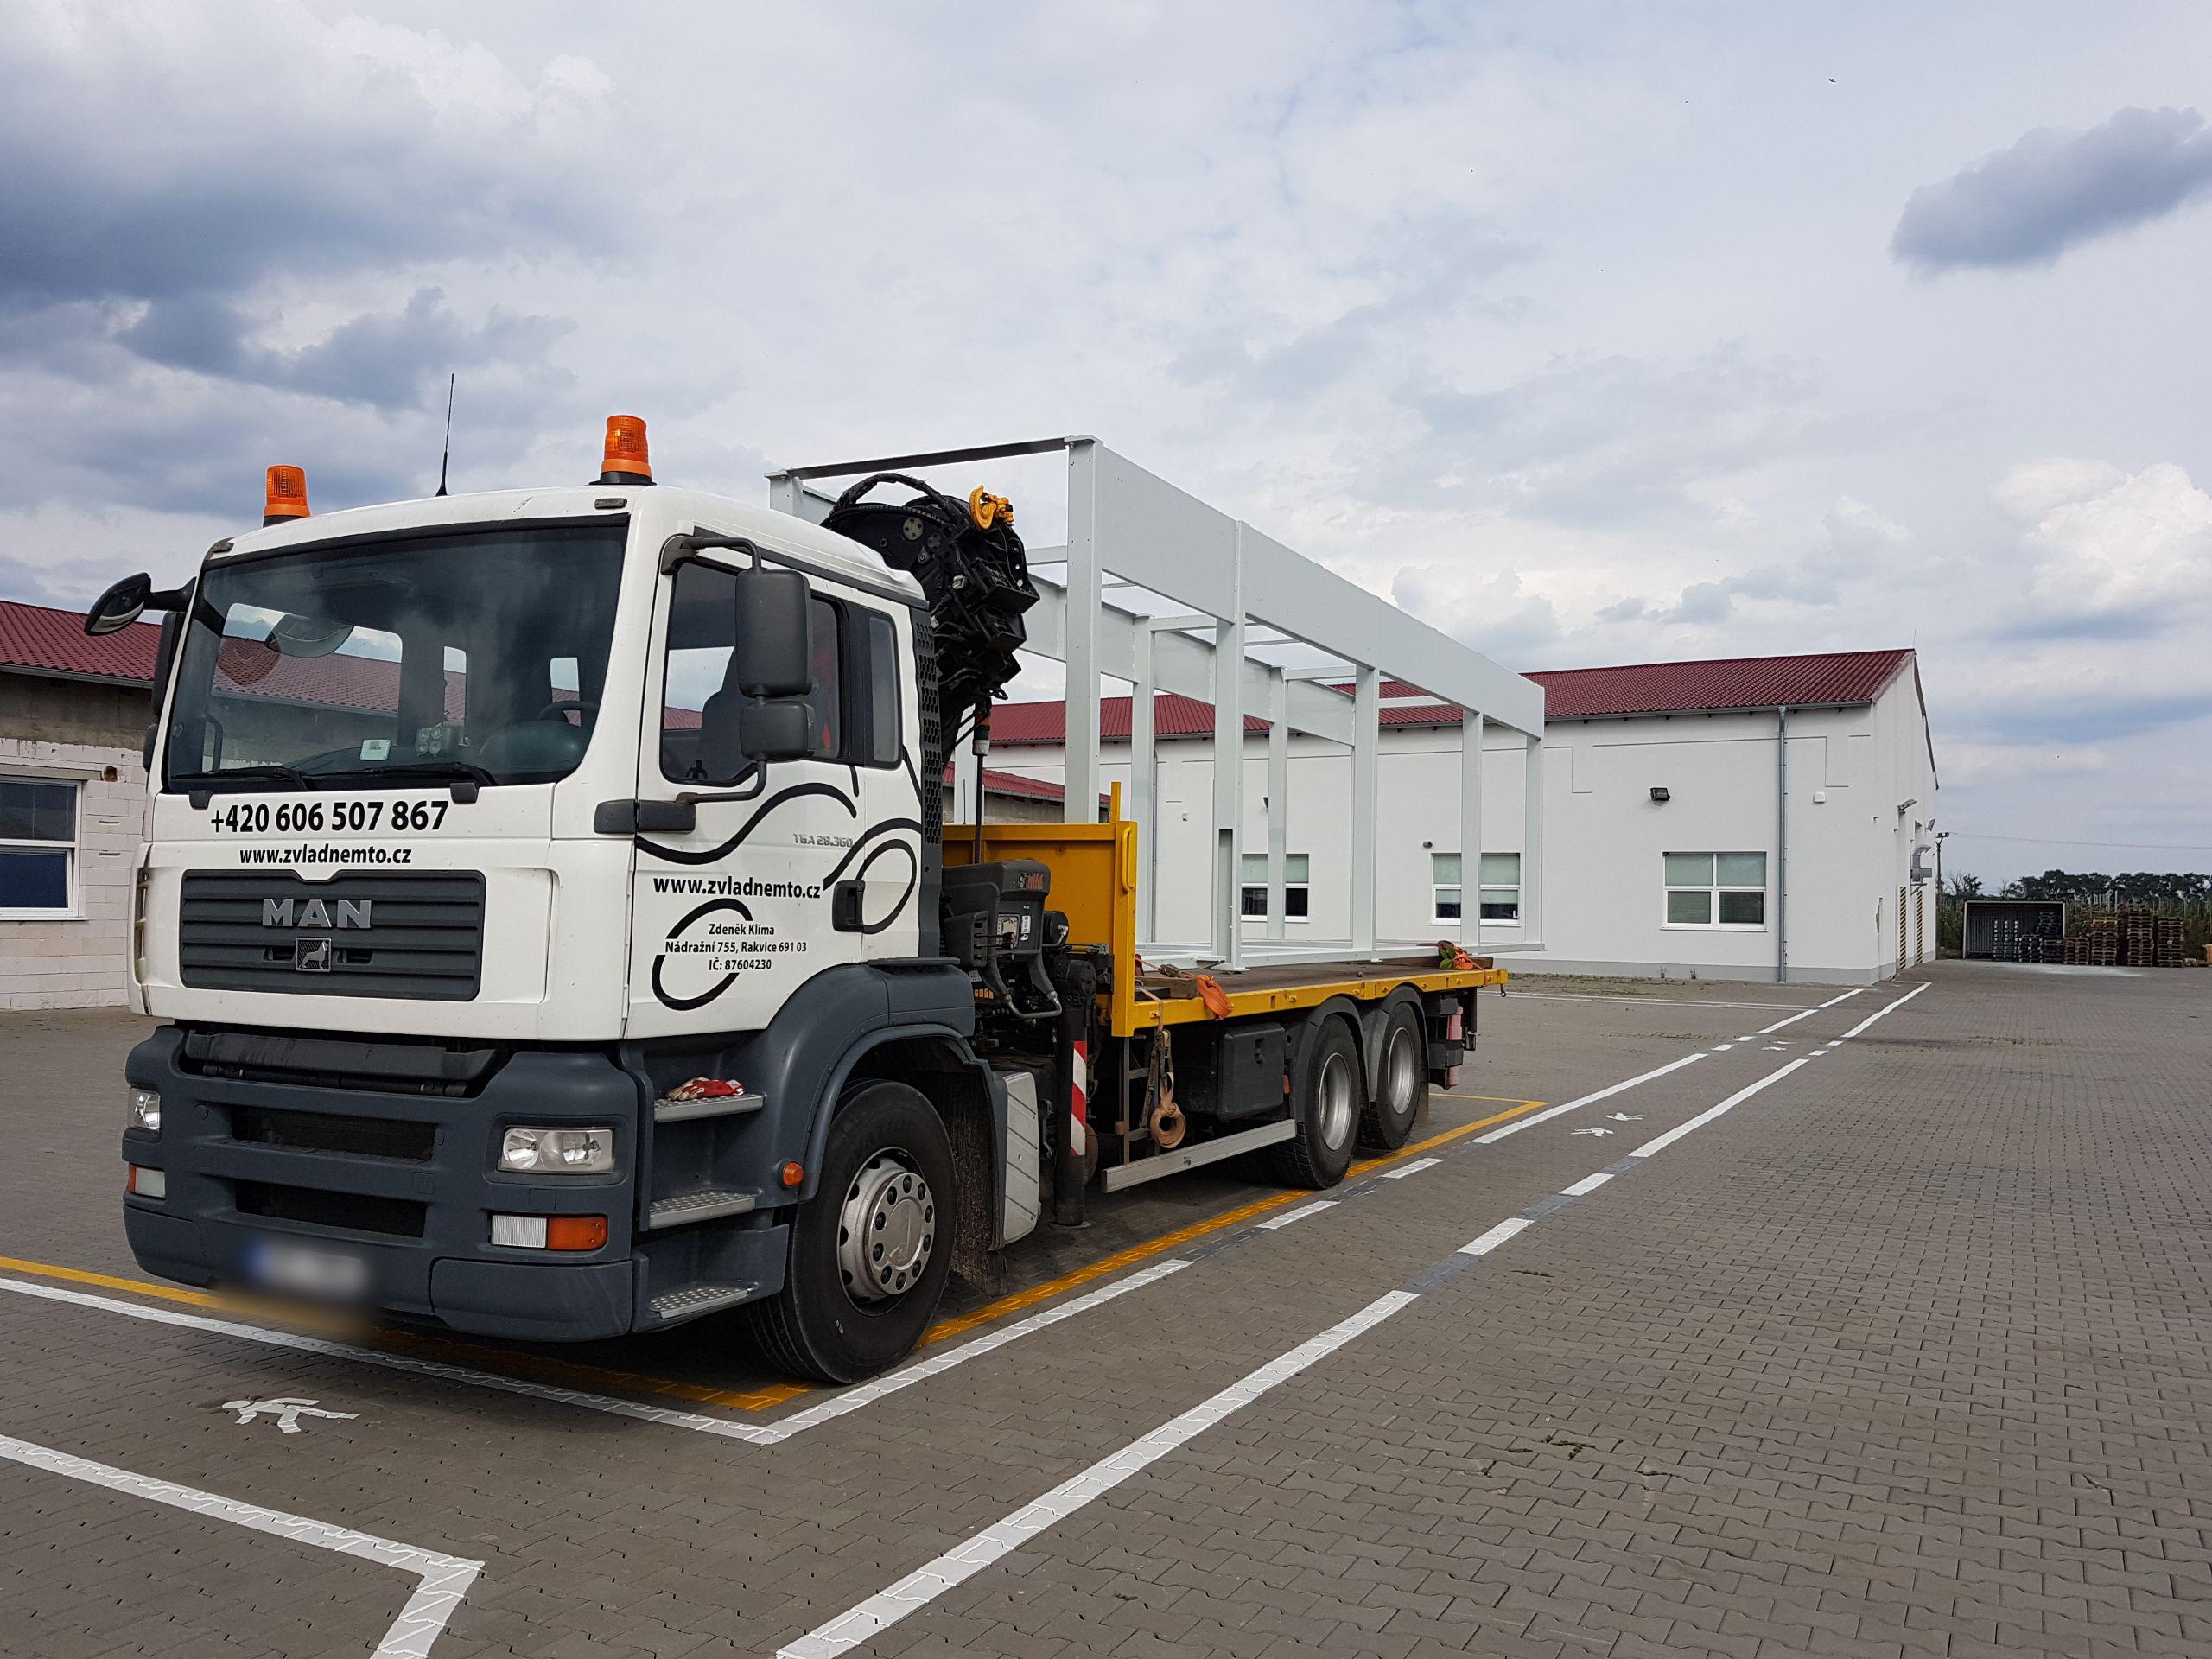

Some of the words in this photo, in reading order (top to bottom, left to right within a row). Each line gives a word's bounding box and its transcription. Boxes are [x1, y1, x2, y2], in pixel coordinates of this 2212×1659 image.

[211, 804, 270, 833] +420
[276, 802, 324, 831] 606
[332, 802, 384, 831] 507
[391, 800, 449, 830] 867
[793, 833, 815, 845] TGA
[239, 843, 412, 865] www.zvladnemto.cz
[653, 875, 821, 899] www.zvladnemto.cz
[262, 899, 372, 929] MAN
[709, 923, 746, 935] Zdeněk
[748, 923, 775, 935] Klíma
[665, 941, 715, 953] Nádražní
[718, 941, 739, 954] 755,
[741, 941, 777, 952] Rakvice
[709, 957, 722, 970] IČ:
[724, 959, 772, 970] 87604230
